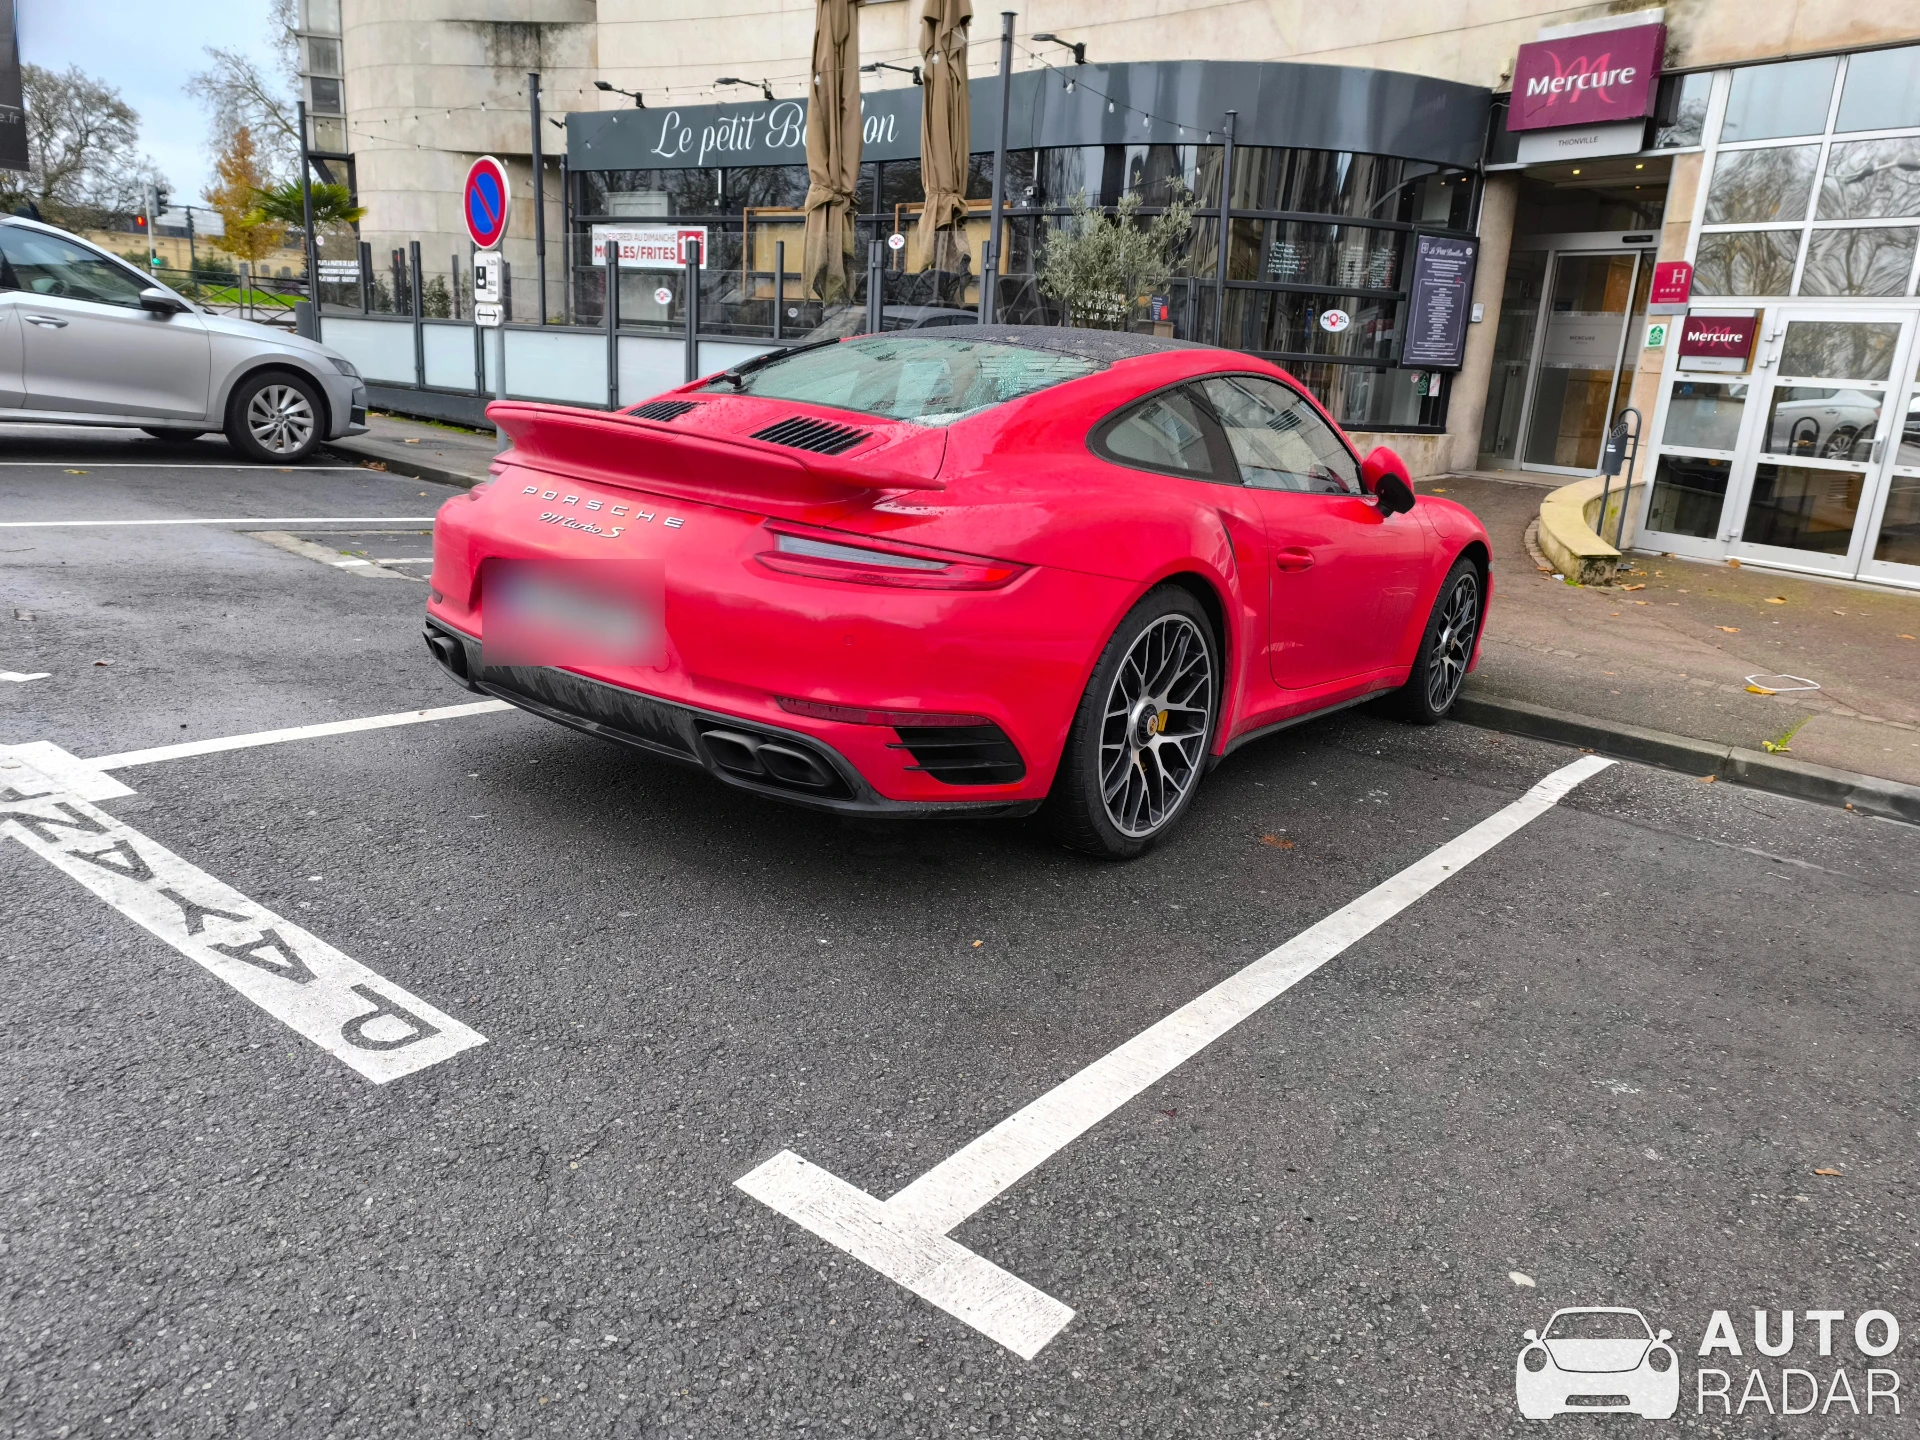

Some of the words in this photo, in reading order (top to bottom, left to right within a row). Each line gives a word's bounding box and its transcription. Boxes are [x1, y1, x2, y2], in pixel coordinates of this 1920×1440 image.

[1526, 67, 1637, 97] Mercure
[650, 110, 695, 158] Le
[698, 109, 766, 166] petit
[1558, 136, 1599, 147] THIONVILLE
[644, 233, 676, 243] DIMANCHE
[594, 245, 676, 260] MLES/FRITES
[1671, 268, 1688, 285] H
[1323, 313, 1347, 326] MOSL
[1687, 331, 1743, 343] Mercure
[522, 485, 686, 529] PORSCHE
[538, 511, 564, 526] 911
[599, 526, 626, 539] S
